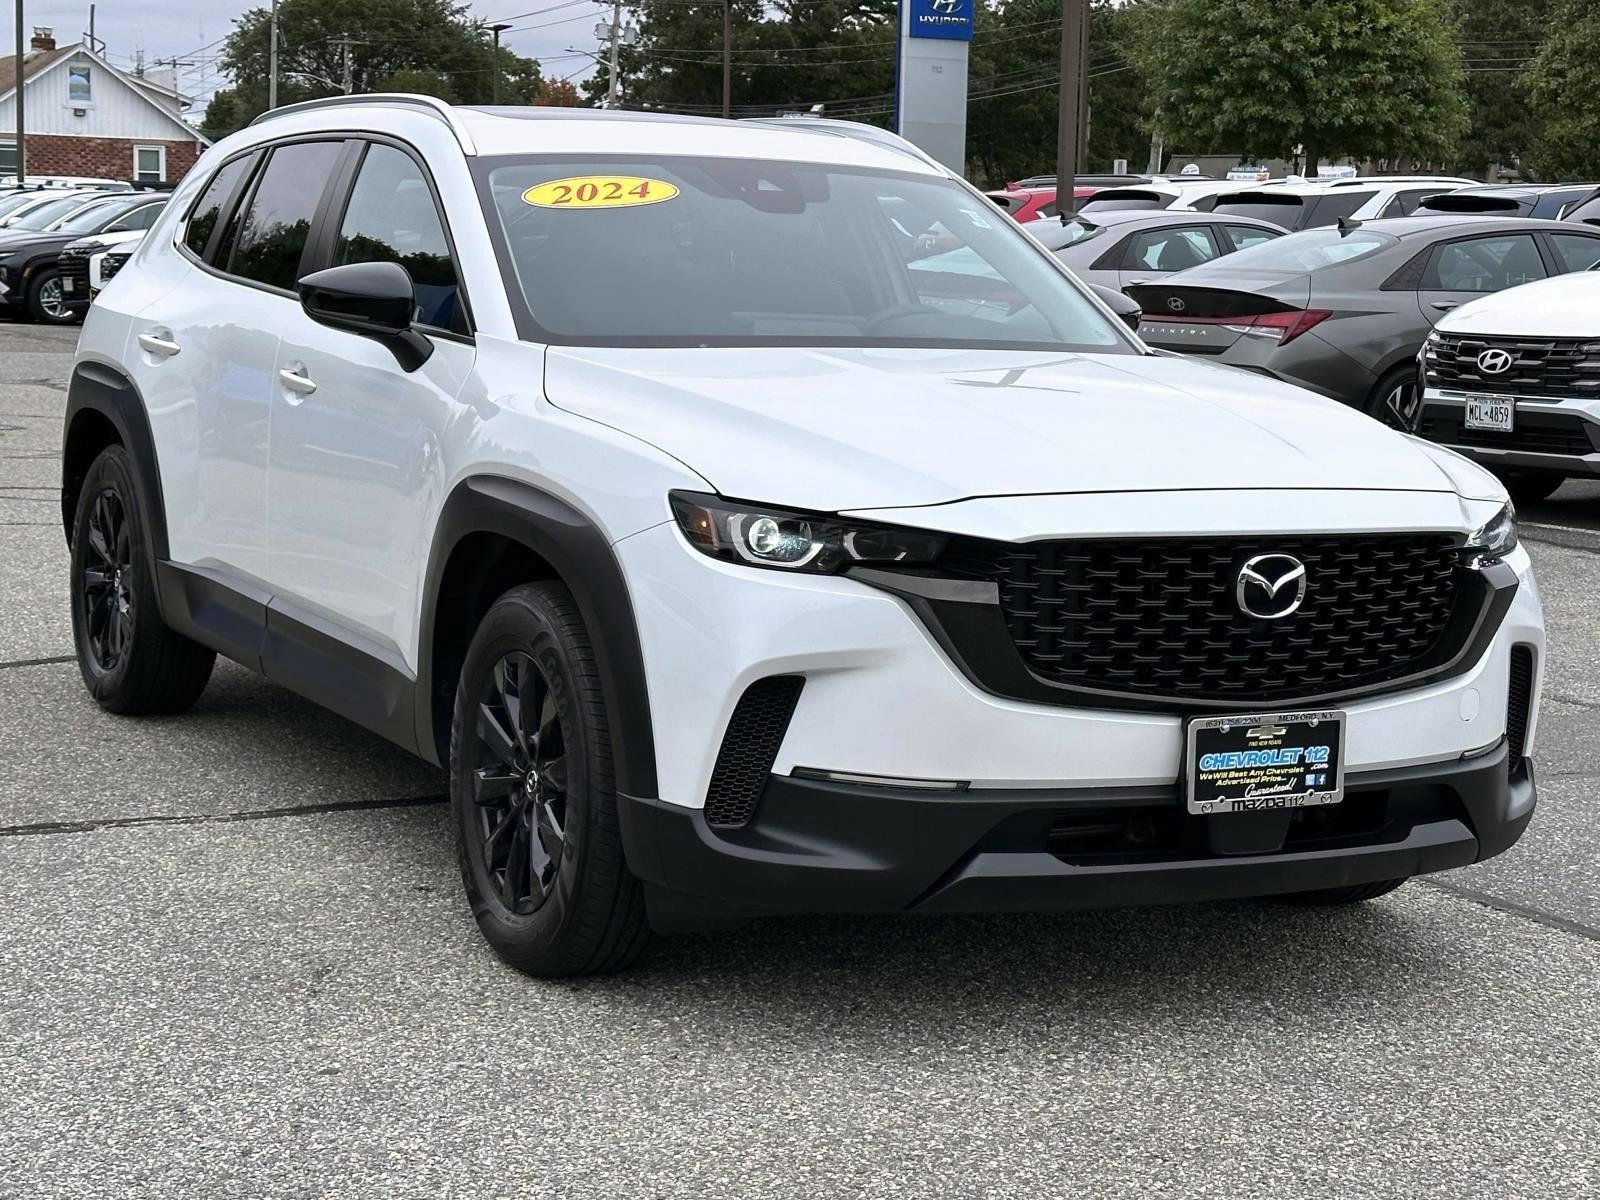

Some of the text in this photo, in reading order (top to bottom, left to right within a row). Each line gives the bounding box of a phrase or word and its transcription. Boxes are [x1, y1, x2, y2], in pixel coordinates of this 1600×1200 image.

[919, 15, 970, 25] HYUNDAI
[551, 181, 651, 205] 2024
[1142, 327, 1207, 336] ELANTRA
[1199, 745, 1330, 771] CHEVROLET 112
[1249, 768, 1265, 777] Any
[1265, 766, 1304, 776] Chevrolet
[1215, 776, 1260, 786] Advertised
[1287, 795, 1305, 807] 112
